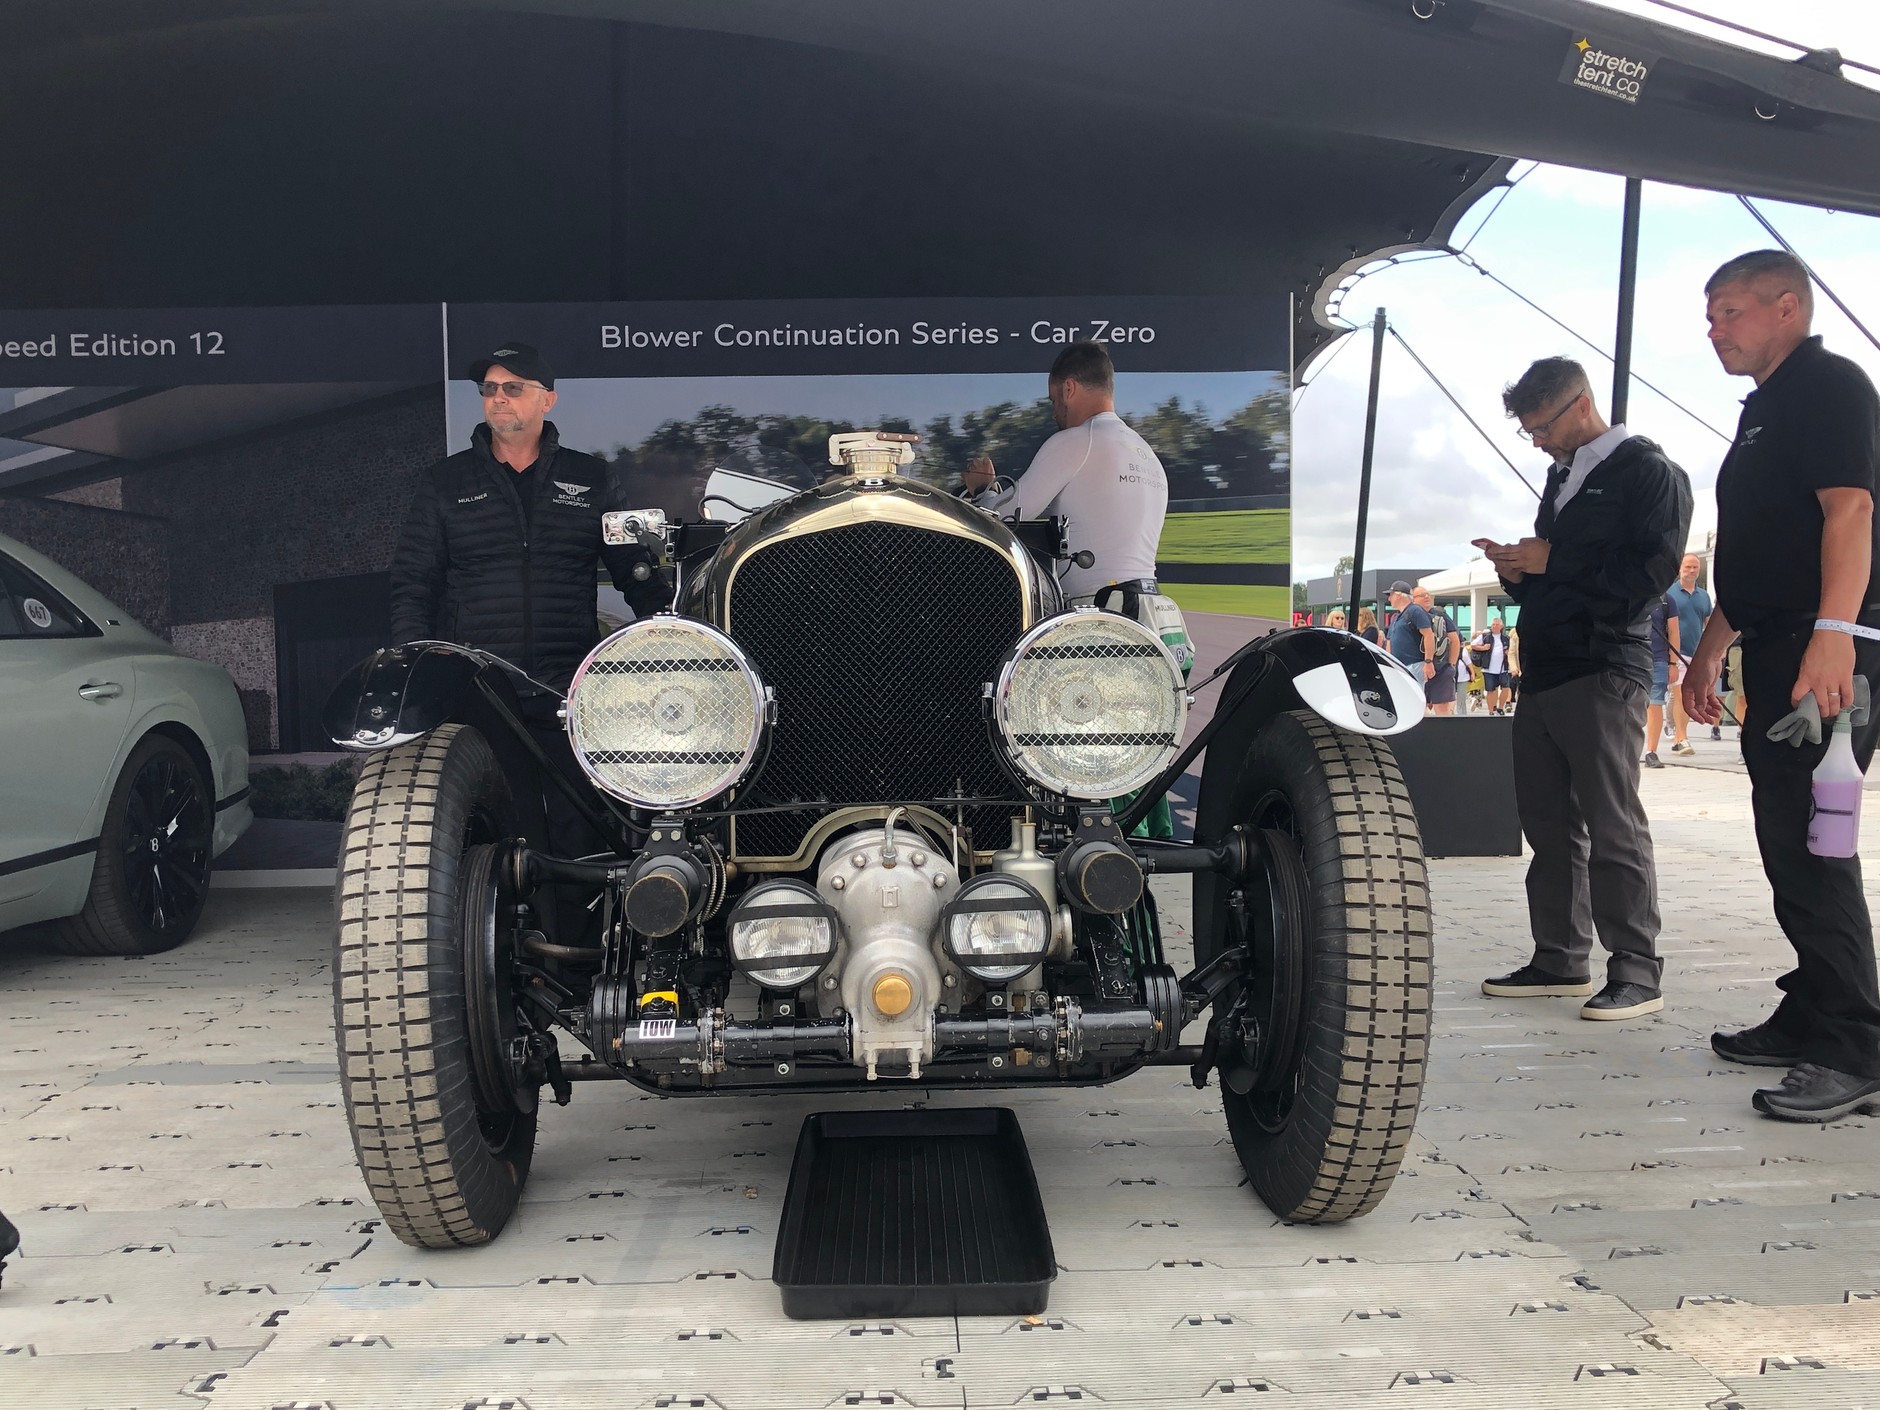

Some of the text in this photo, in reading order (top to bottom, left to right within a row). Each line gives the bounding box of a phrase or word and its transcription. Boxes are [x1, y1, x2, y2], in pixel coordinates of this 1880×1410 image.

[1577, 62, 1615, 87] tent
[1583, 50, 1647, 80] stretch
[1573, 77, 1637, 103] thestretchtent.co.uk
[0, 331, 225, 357] eed Edition 12
[601, 325, 703, 348] Blower
[714, 322, 900, 347] Continuation
[911, 321, 999, 345] Series
[1030, 320, 1080, 343] Car
[1090, 320, 1156, 343] Zero
[458, 492, 488, 504] MULLINER
[552, 498, 591, 509] MOTORSPORT
[558, 493, 585, 502] BENTLEY
[28, 604, 47, 621] 667
[643, 1020, 674, 1037] TOW
